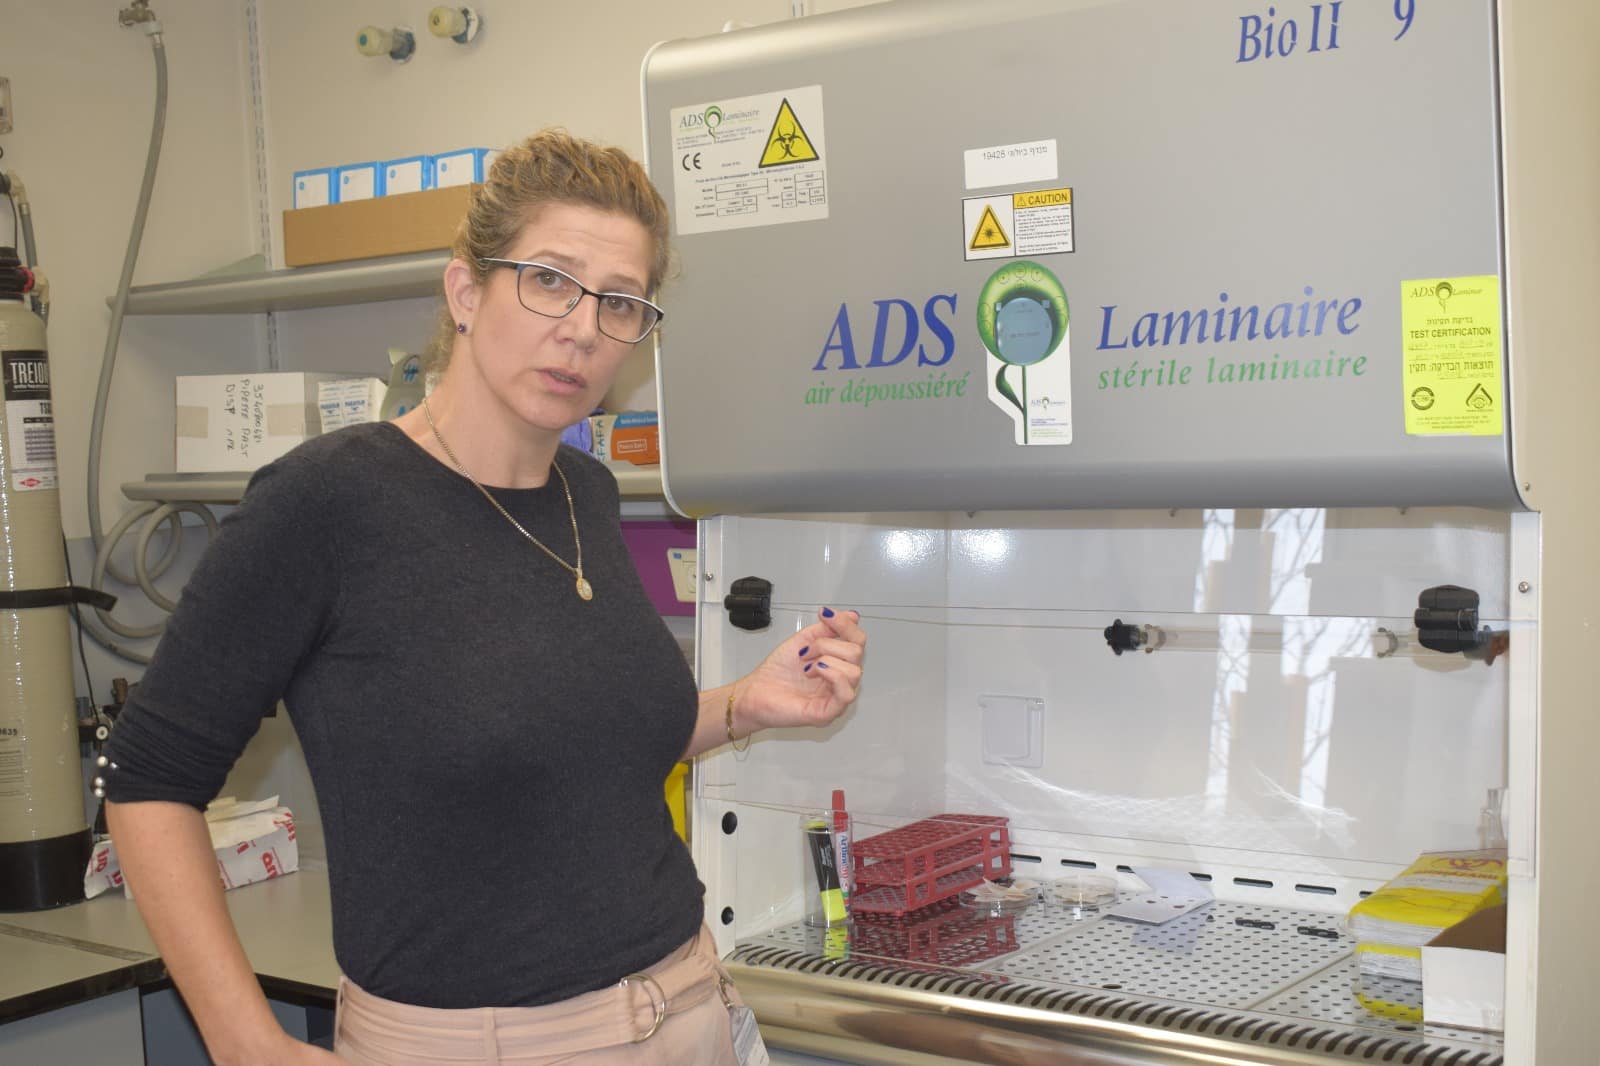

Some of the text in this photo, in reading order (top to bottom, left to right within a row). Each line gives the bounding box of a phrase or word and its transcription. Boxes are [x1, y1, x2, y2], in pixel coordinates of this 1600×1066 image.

[1236, 6, 1297, 63] Bio
[679, 112, 705, 129] ADS
[1028, 193, 1068, 206] CAUTION
[1409, 285, 1436, 298] ADS
[812, 286, 1363, 371] ADS Laminaire
[1409, 326, 1492, 339] TEST CERTIFICATION
[1097, 349, 1368, 390] stérile laminaire
[804, 370, 971, 408] air dépoussiéré
